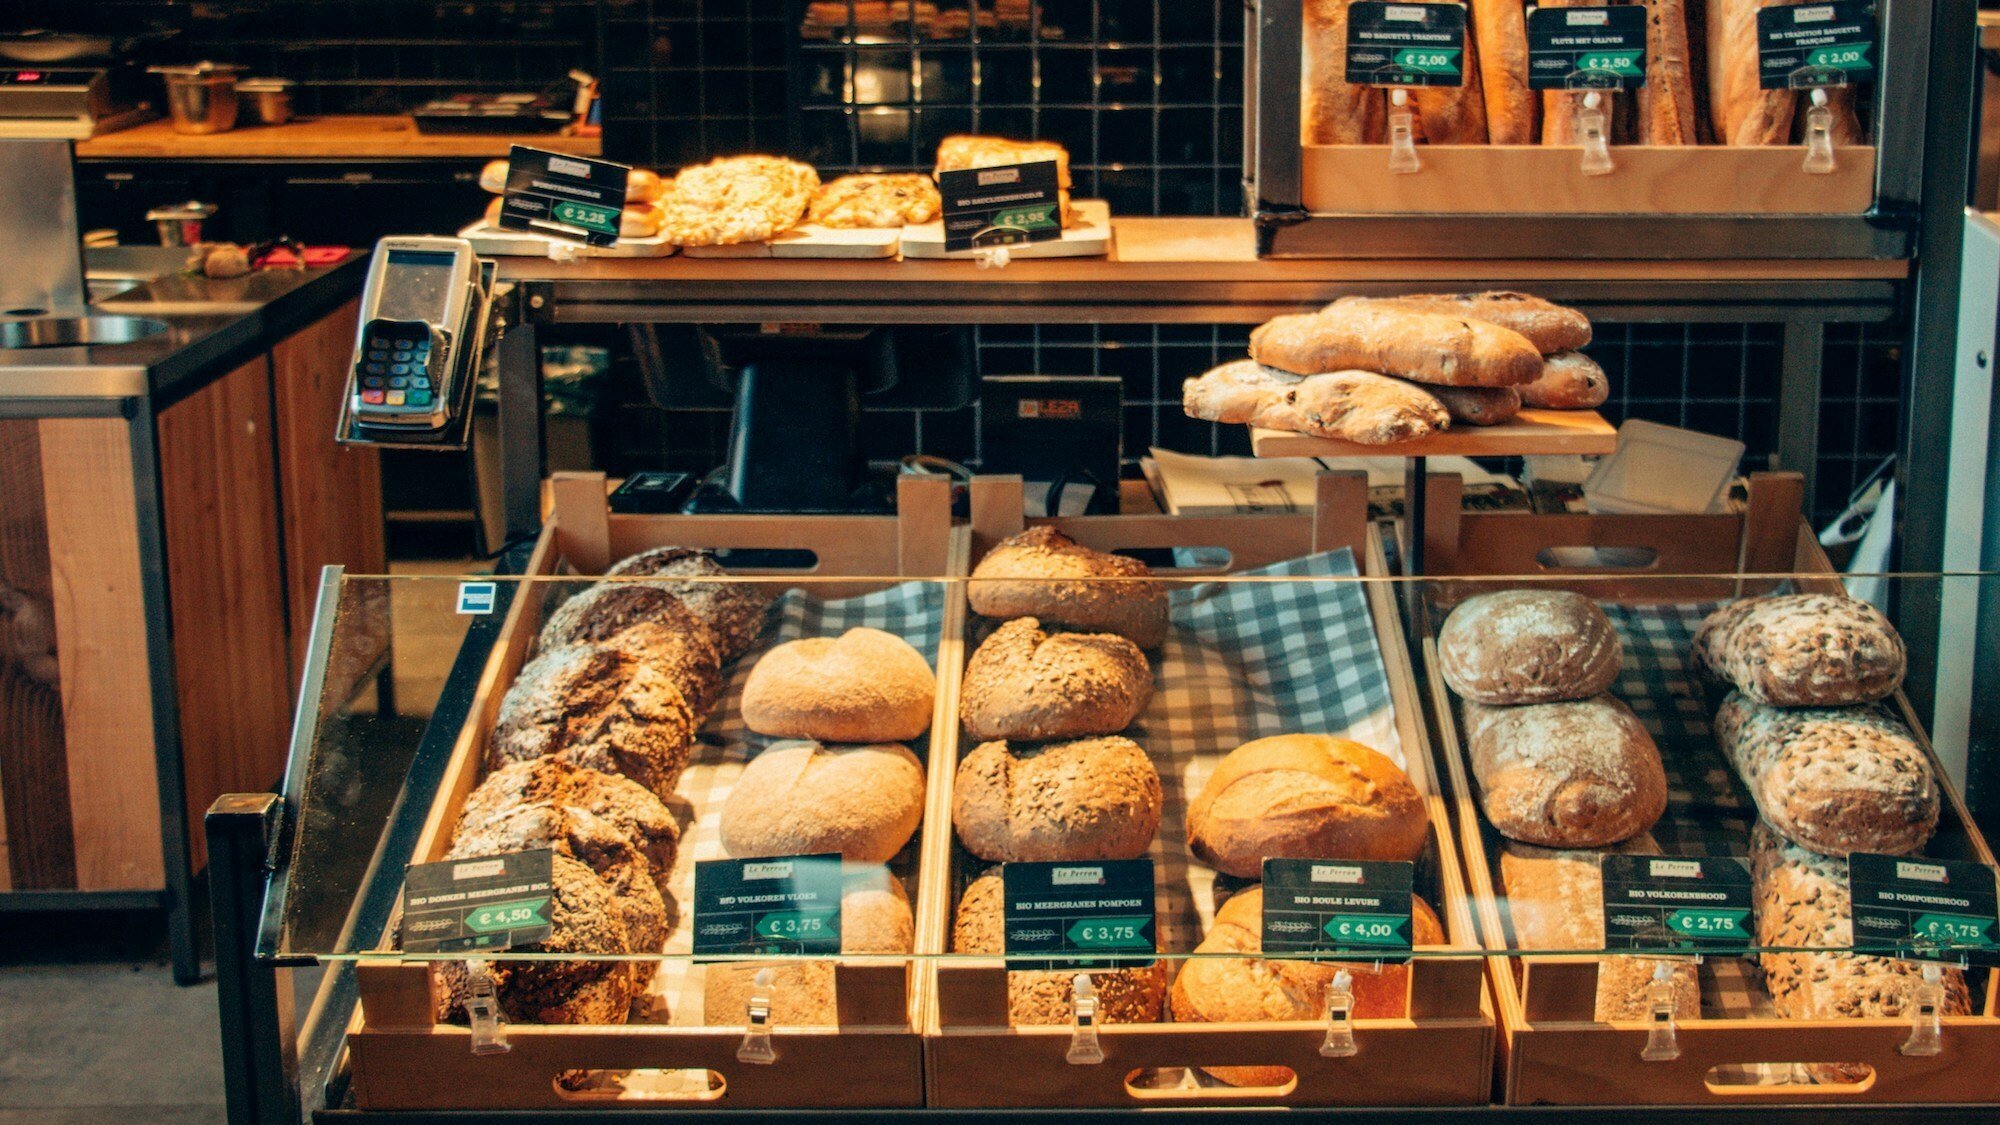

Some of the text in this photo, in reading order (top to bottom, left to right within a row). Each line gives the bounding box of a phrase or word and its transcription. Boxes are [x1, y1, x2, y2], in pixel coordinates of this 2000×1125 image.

[1374, 32, 1410, 40] BAGUETTE
[1784, 30, 1822, 38] TRADITION
[1823, 26, 1861, 35] BAGUETTE
[1406, 54, 1447, 66] € 2,00
[1589, 58, 1630, 69] € 2,50
[1818, 52, 1858, 64] € 2,00
[564, 207, 606, 224] € 2,25
[1004, 212, 1045, 226] € 2,95
[410, 883, 550, 906] BIO DONKER MEERGRANEN BOL
[720, 892, 817, 905] BIO VOLKOREN VLOER
[1646, 890, 1727, 900] VOLKORENBROOD
[1878, 892, 1970, 907] BIO POMPOENBROOD
[1034, 900, 1096, 910] MEERGRANEN
[1099, 899, 1142, 908] POMPOEN
[1312, 897, 1342, 905] BOULE
[1344, 897, 1380, 906] LEVURE
[480, 908, 532, 924] € 4,50
[770, 919, 821, 933] € 3,75
[1682, 916, 1734, 931] € 2,75
[1082, 926, 1134, 941] € 3,75
[1339, 923, 1391, 938] € 4,00
